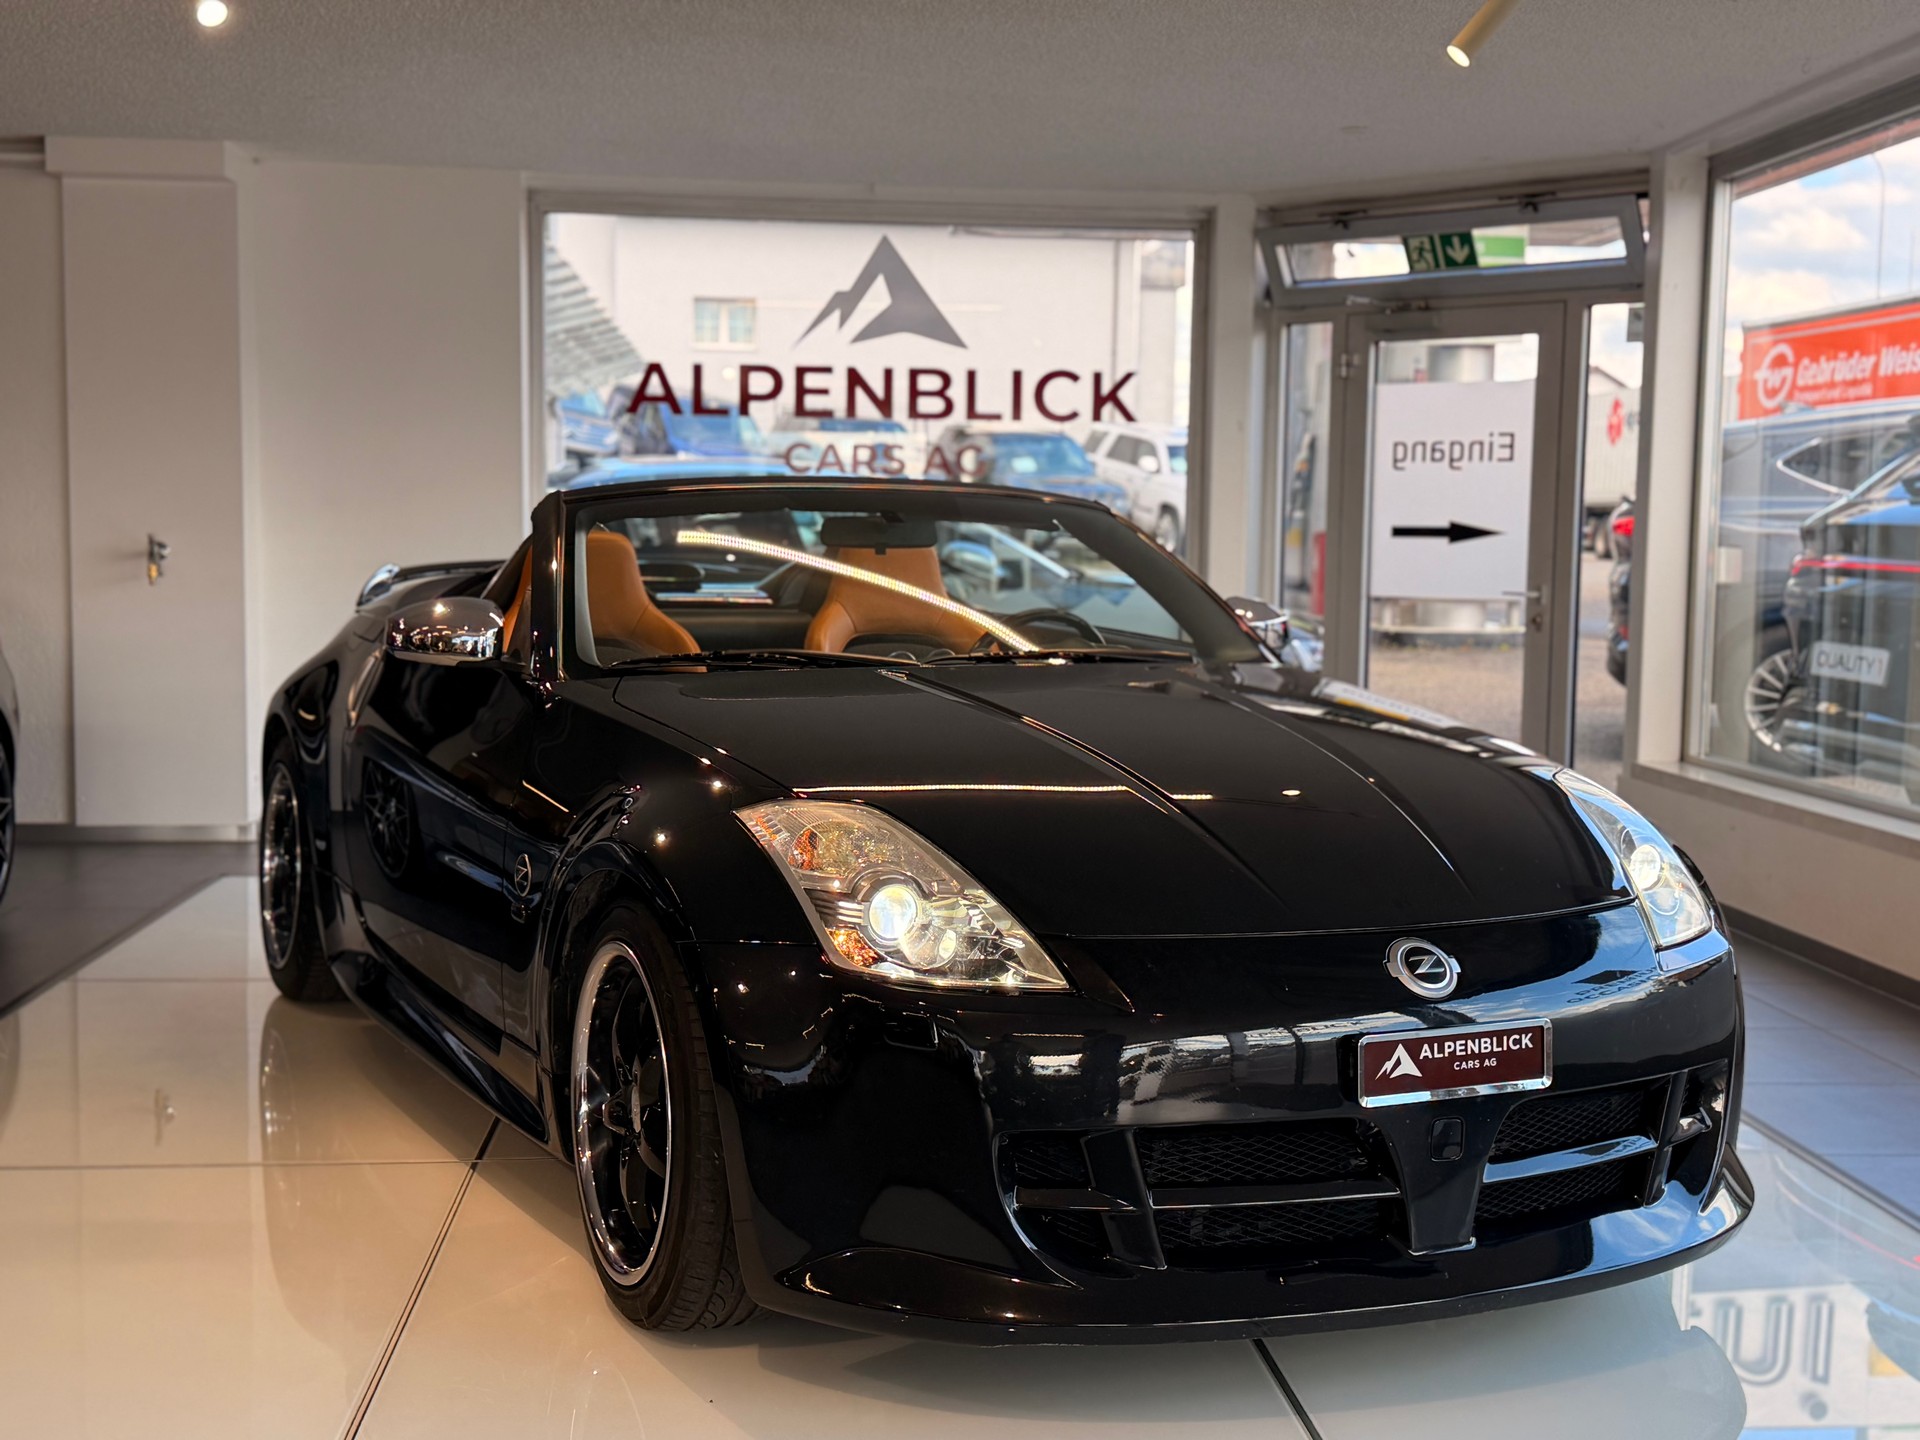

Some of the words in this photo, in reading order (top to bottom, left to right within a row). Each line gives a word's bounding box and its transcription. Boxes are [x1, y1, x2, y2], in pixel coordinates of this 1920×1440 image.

[1795, 351, 1877, 387] Gebrüder
[625, 361, 1138, 423] ALPENBLICK
[783, 442, 904, 477] CARS
[922, 445, 989, 479] AG
[1419, 1032, 1534, 1060] ALPENBLICK
[1453, 1059, 1480, 1071] CARS
[1483, 1057, 1497, 1068] AG
